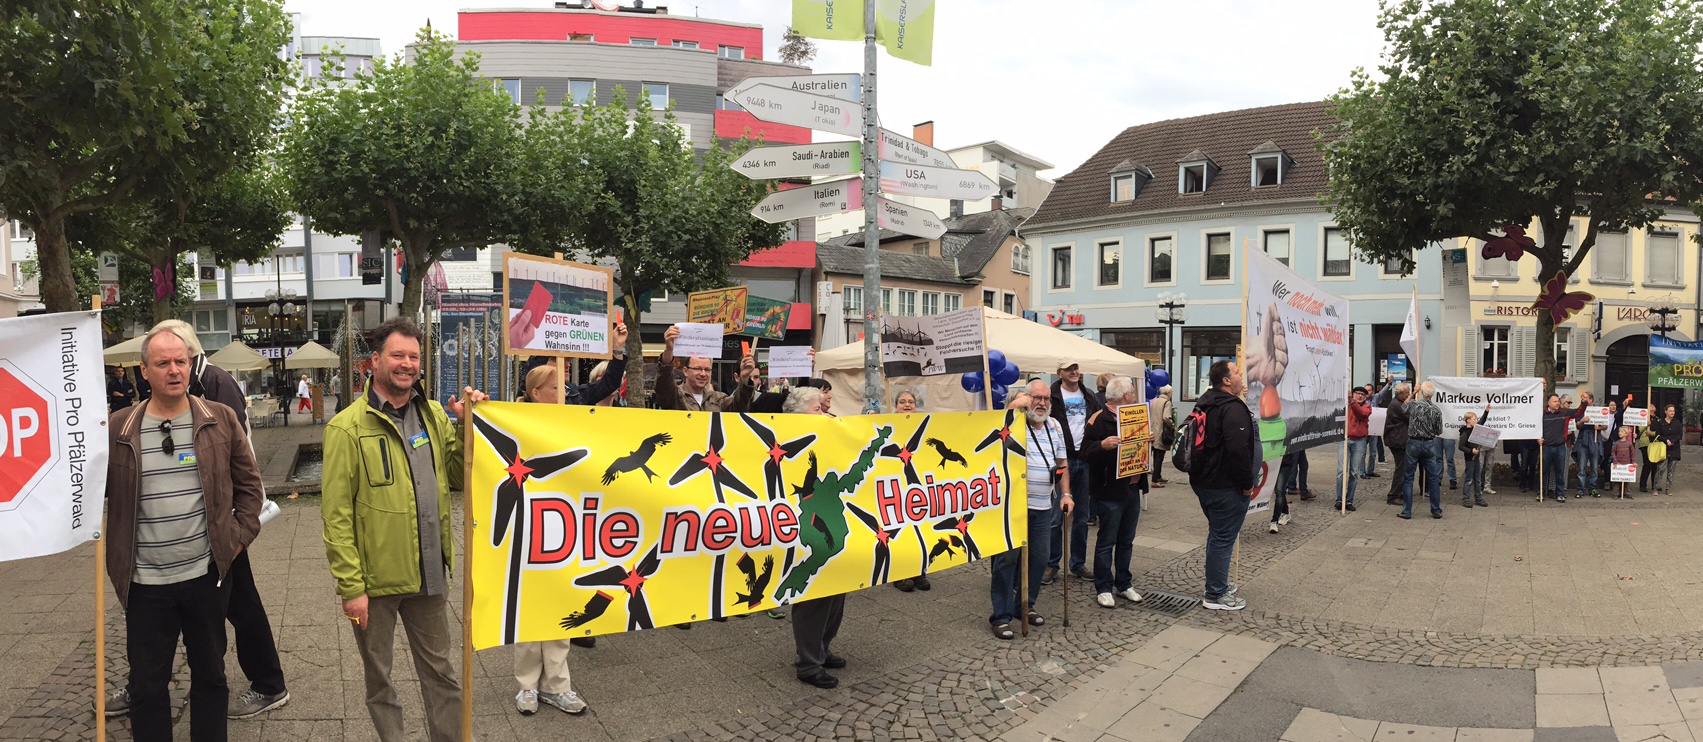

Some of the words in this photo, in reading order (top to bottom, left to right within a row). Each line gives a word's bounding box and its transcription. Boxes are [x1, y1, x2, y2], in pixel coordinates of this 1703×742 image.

[791, 79, 847, 91] Australien
[746, 96, 766, 108] 9448
[769, 101, 782, 111] km
[811, 100, 841, 116] Japan
[880, 132, 904, 150] Trinidad
[905, 142, 910, 151] &
[911, 142, 928, 158] Tobago
[742, 160, 761, 169] 4346
[764, 159, 776, 168] km
[812, 162, 831, 170] (Riad)
[905, 169, 926, 180] USA
[959, 180, 976, 189] 6869
[978, 182, 991, 191] km
[760, 204, 771, 213] 914
[773, 203, 784, 212] km
[814, 187, 840, 200] Italien
[819, 200, 836, 209] (Rom)
[884, 203, 908, 218] Spanien
[923, 220, 933, 229] 1349
[932, 222, 941, 230] km
[890, 217, 905, 227] (Madrid)
[1272, 279, 1291, 300] Wer
[1324, 304, 1340, 320] will,
[544, 314, 568, 326] ROTE
[570, 318, 589, 328] Karte
[1286, 316, 1298, 335] ist
[1299, 317, 1323, 341] nicht
[544, 330, 567, 339] gegen
[569, 329, 605, 341] GRÜNEN
[544, 340, 581, 351] Wahnsinn
[582, 344, 590, 352] !!!
[935, 342, 953, 351] Stoppt
[939, 346, 975, 356] Feldversuche
[60, 326, 81, 393] Initiative
[1436, 391, 1481, 404] Markus
[1486, 392, 1535, 404] Vollmer
[65, 397, 82, 427] Pro
[67, 431, 87, 530] Pfälzerwald
[528, 497, 641, 566] Die
[660, 503, 799, 554] neue
[876, 466, 1003, 528] Heimat
